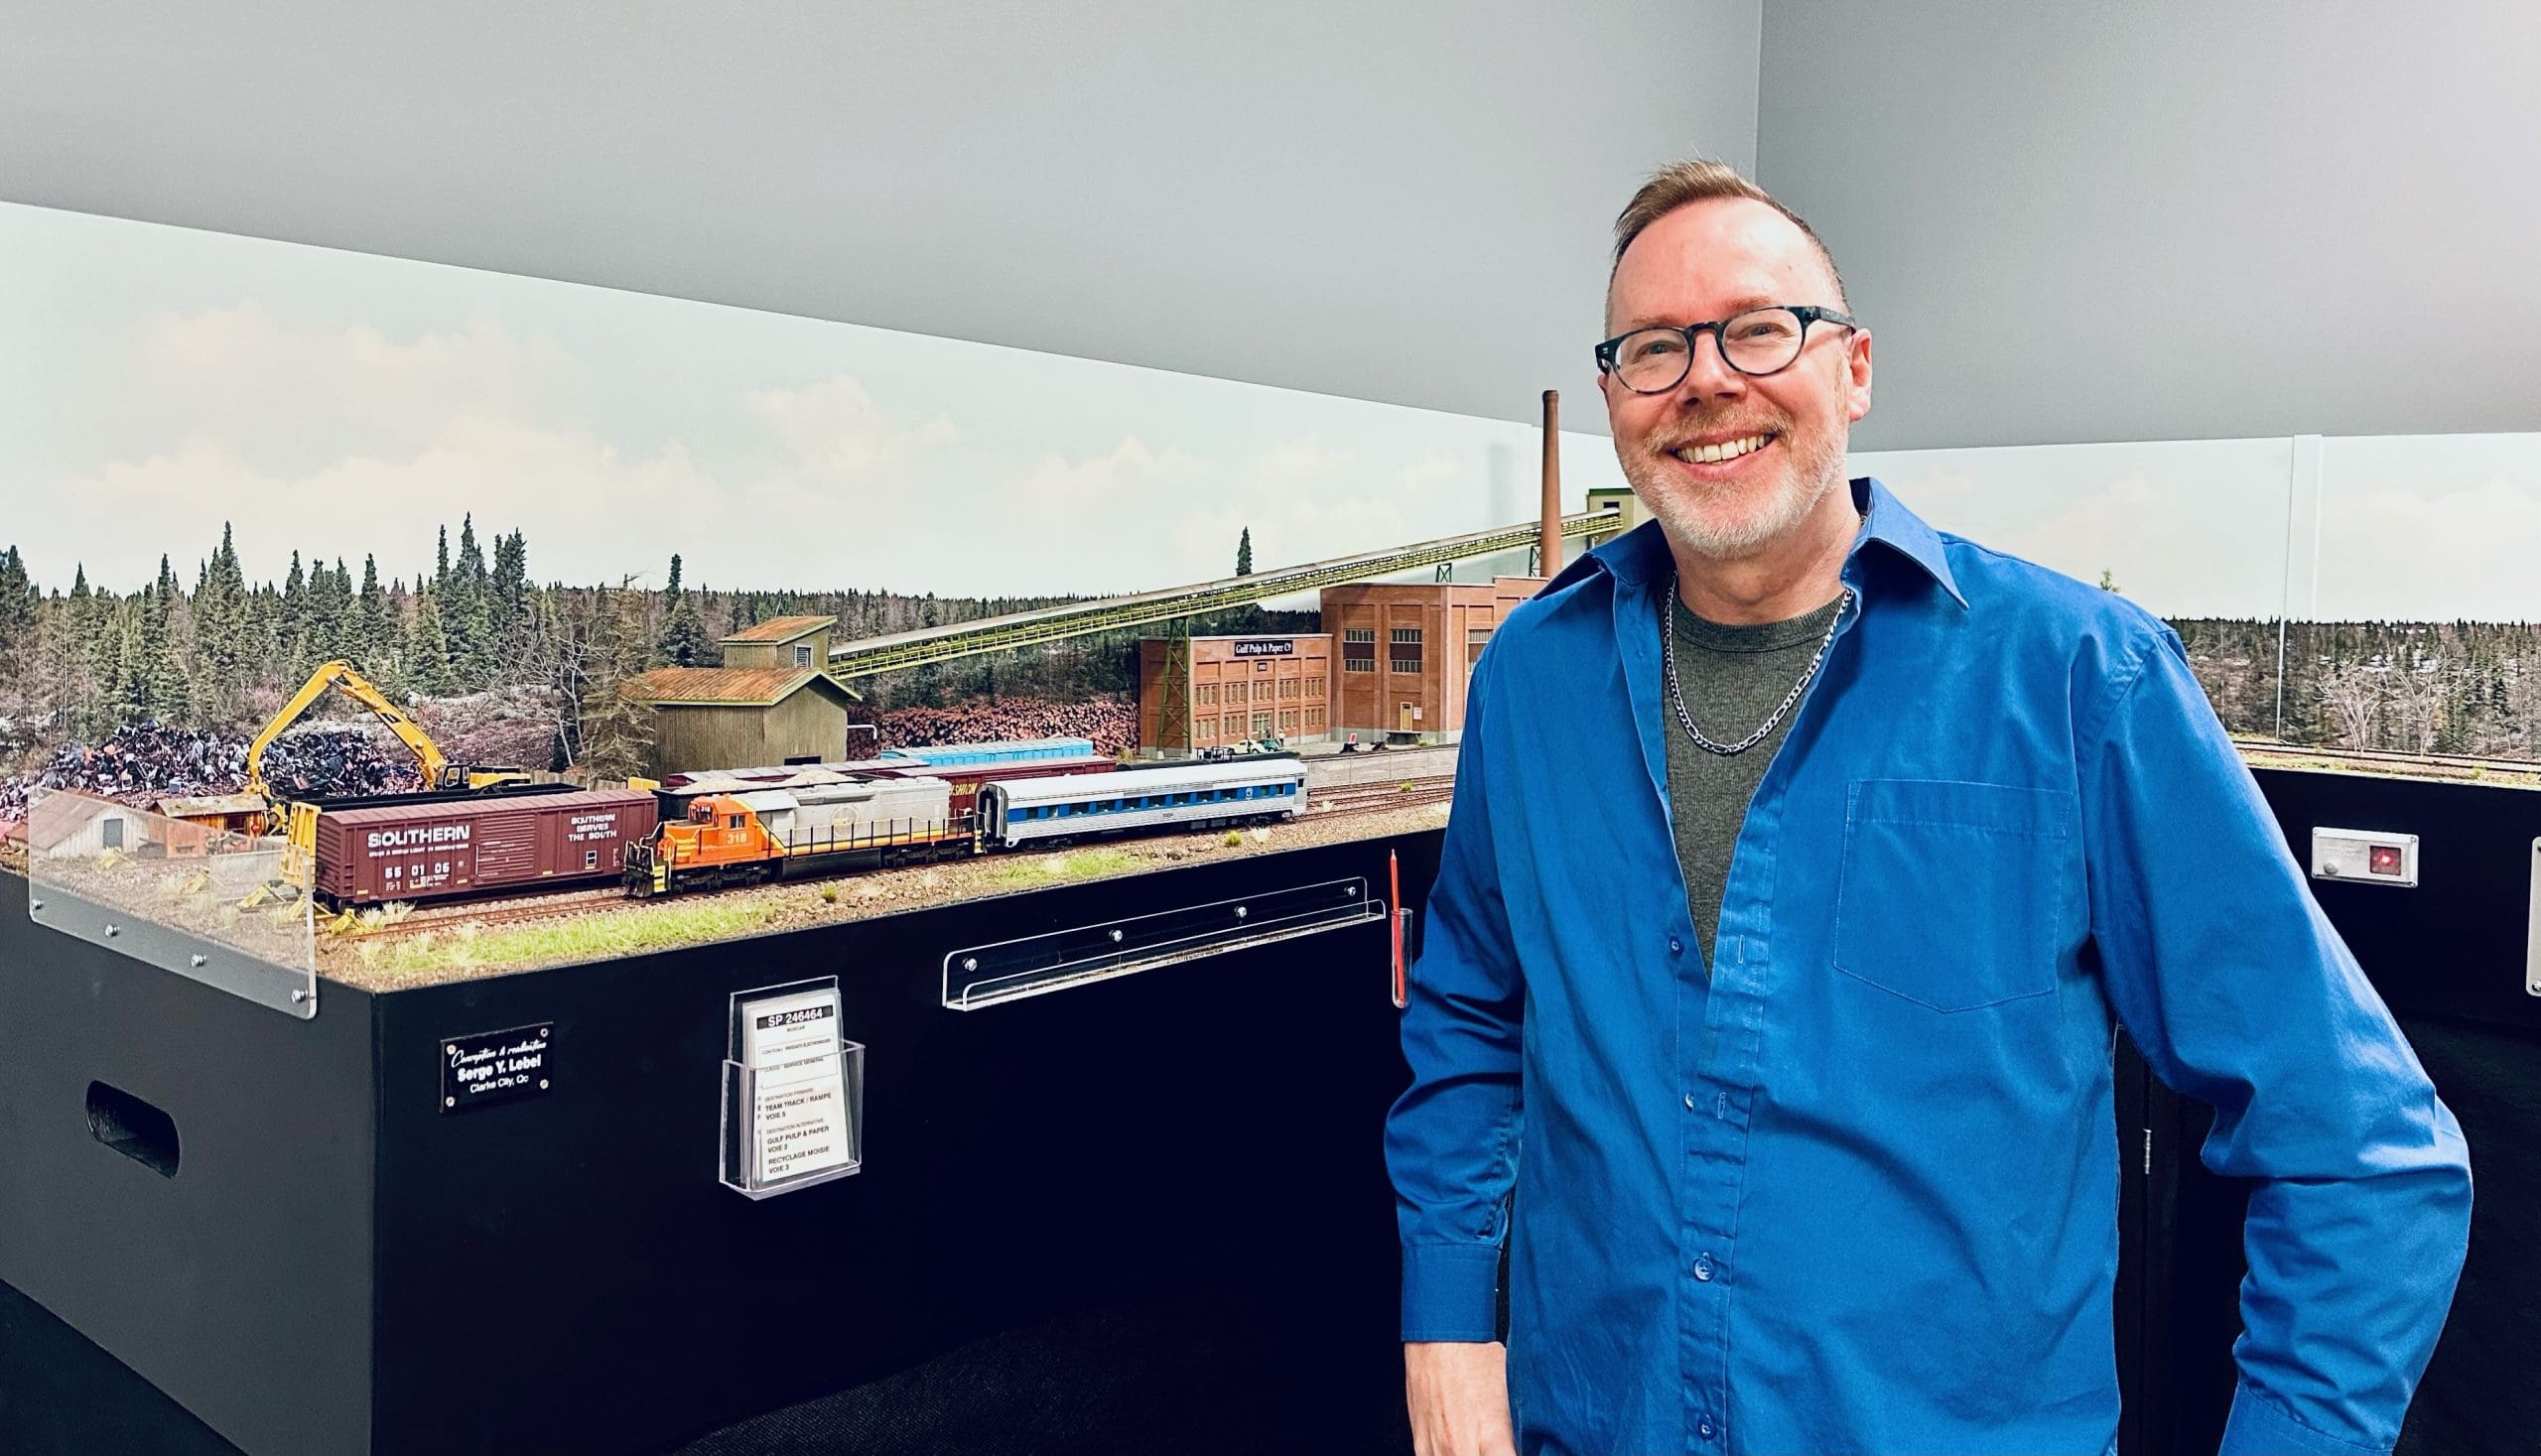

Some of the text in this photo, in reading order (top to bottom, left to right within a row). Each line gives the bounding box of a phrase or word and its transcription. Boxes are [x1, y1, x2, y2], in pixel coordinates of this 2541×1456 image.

[571, 814, 616, 825] SOUTHERN
[577, 823, 609, 833] SERVES
[367, 825, 470, 849] SOUTHERN
[589, 830, 617, 840] SOUTH
[727, 832, 747, 845] 318
[767, 1008, 823, 1027] SP 246464
[452, 1048, 496, 1069] Conception
[458, 1054, 542, 1082] Serge Y. Lebel
[469, 1081, 496, 1094] Clarke
[497, 1077, 515, 1088] City,
[765, 1103, 783, 1112] TEAM
[784, 1099, 805, 1108] TRACK
[810, 1093, 832, 1103] RAMPE
[767, 1135, 784, 1144] GULF
[785, 1132, 802, 1141] PULP
[809, 1125, 830, 1135] PAPER
[768, 1145, 830, 1165] RECYCLAGE MOISIE
